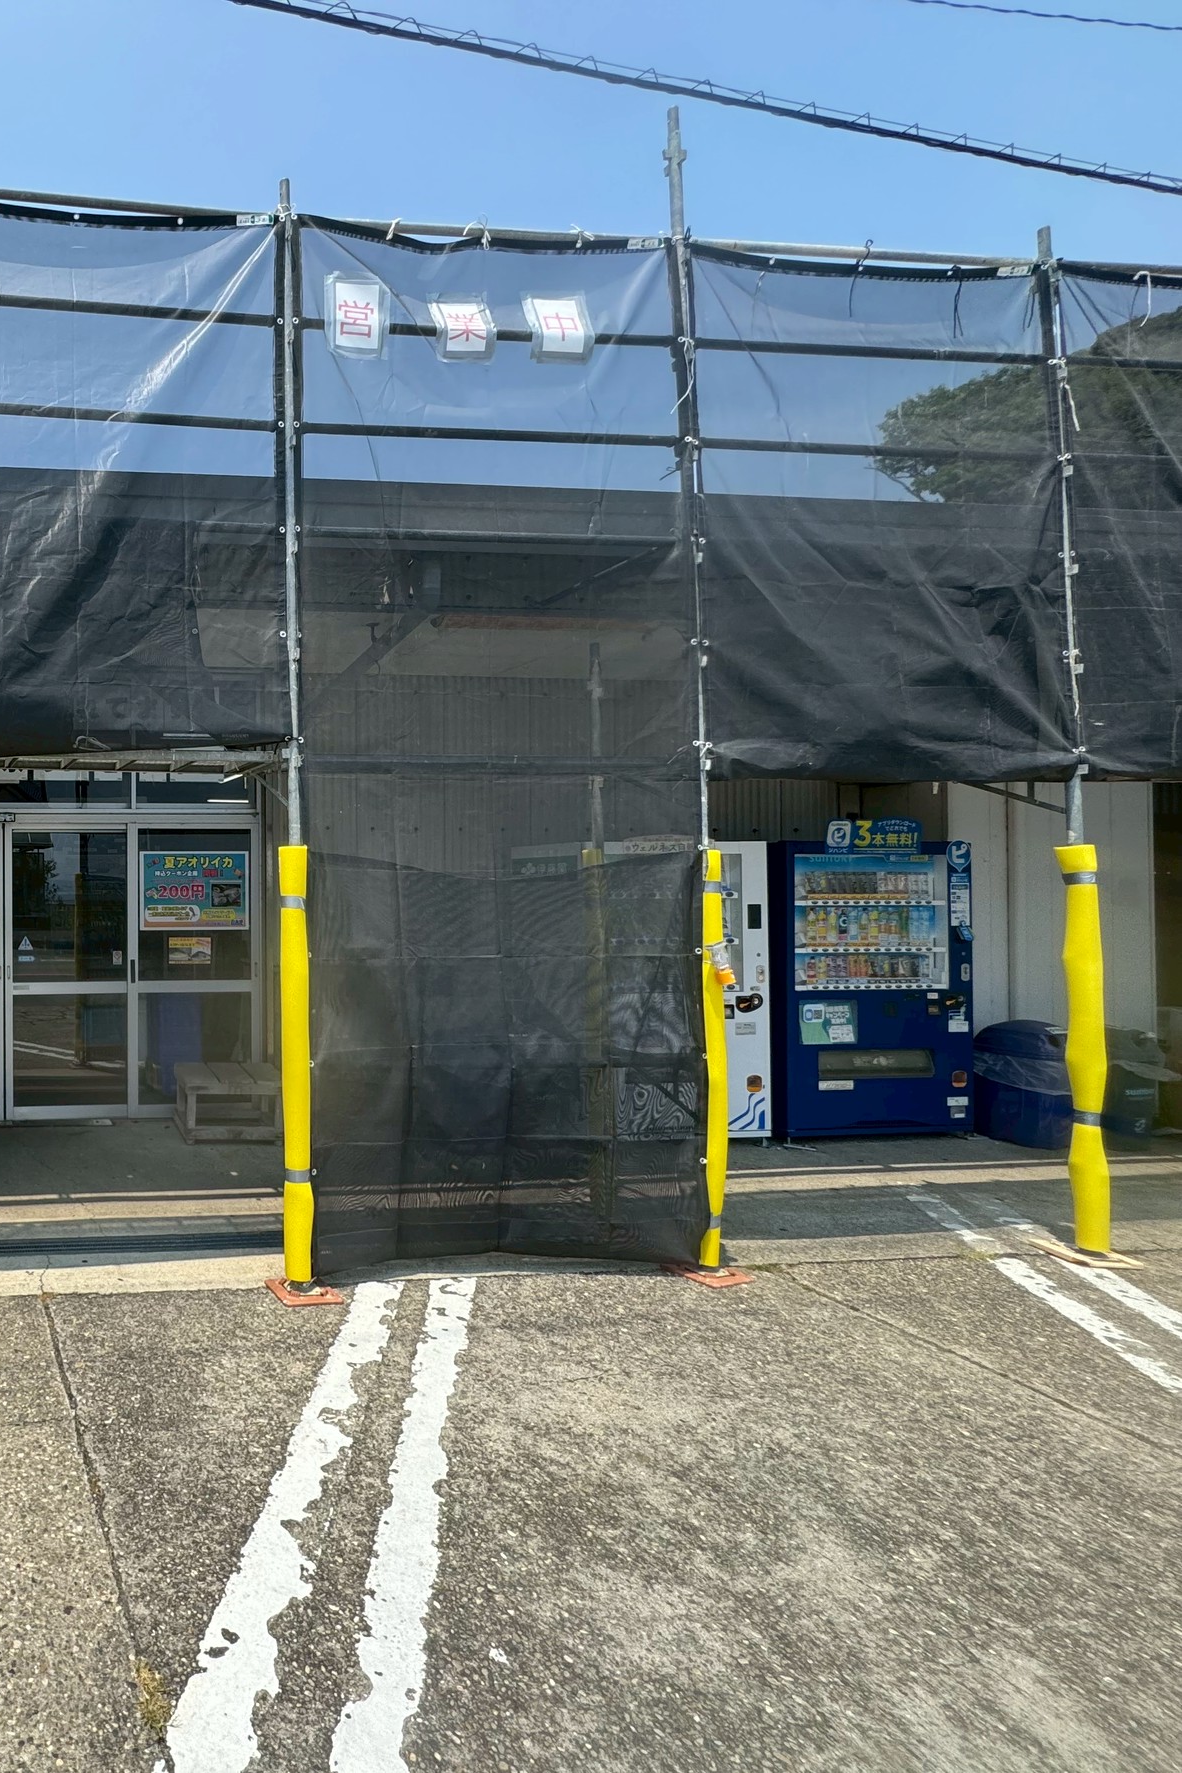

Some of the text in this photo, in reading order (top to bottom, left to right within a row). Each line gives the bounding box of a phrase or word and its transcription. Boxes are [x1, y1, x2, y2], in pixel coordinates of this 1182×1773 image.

[338, 299, 579, 343] 営業中
[164, 857, 233, 869] 夏アオリイカ
[158, 883, 205, 899] 200円
